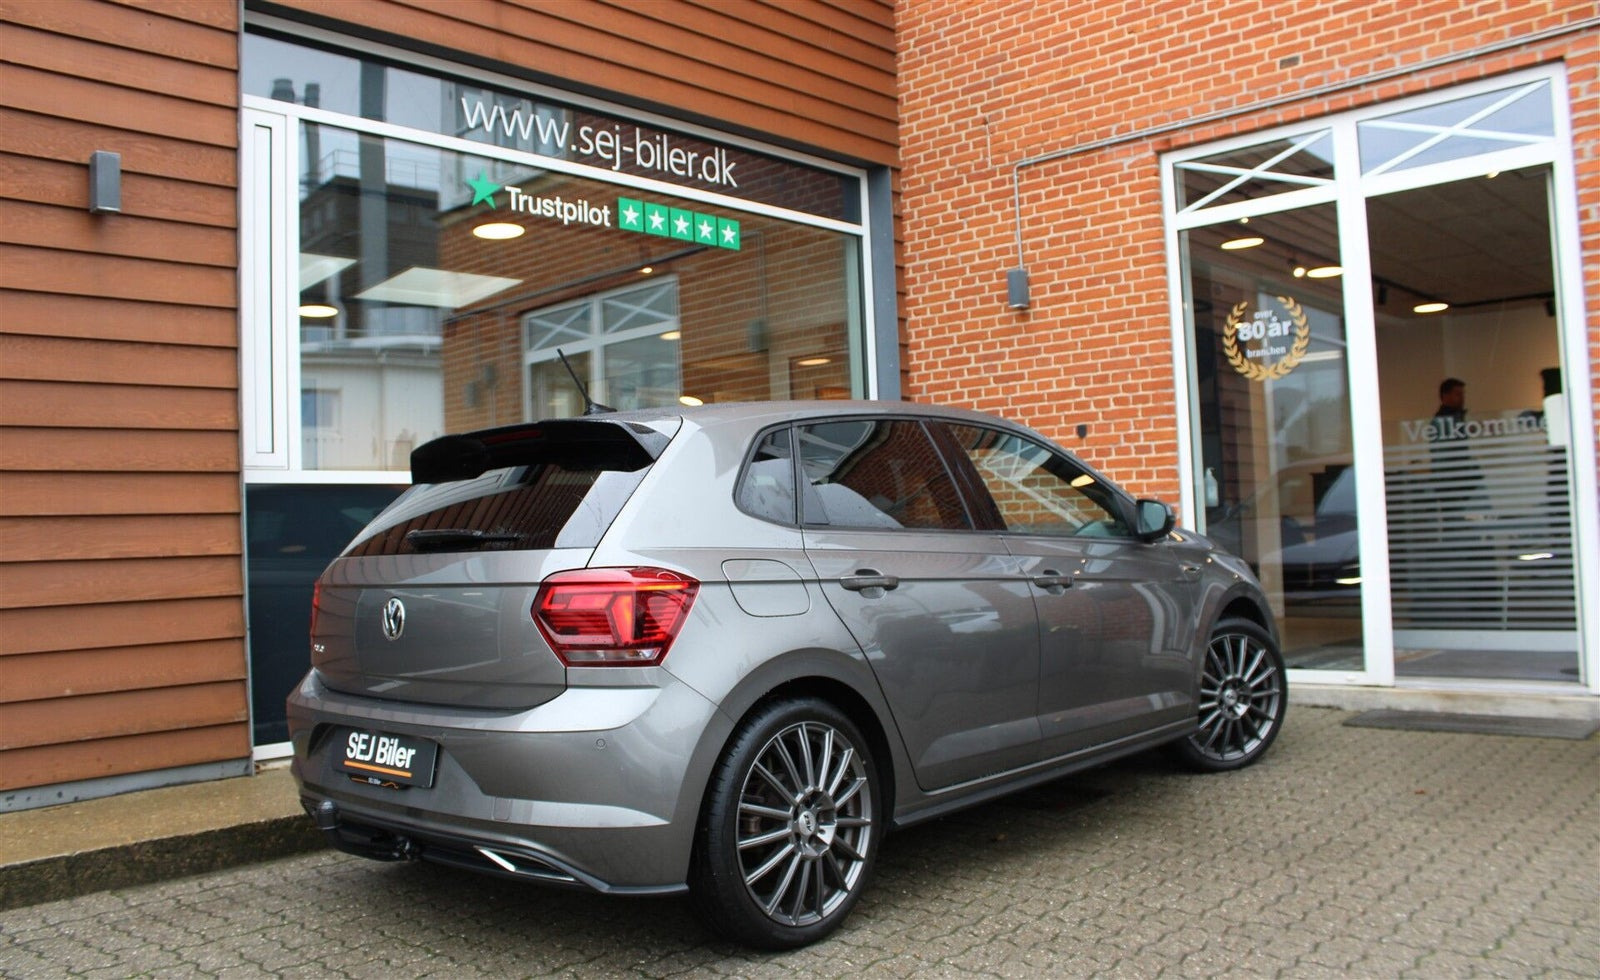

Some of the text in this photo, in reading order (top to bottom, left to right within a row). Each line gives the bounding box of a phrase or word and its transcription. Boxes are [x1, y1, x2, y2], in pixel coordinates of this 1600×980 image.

[461, 97, 738, 188] www.sej-biler.dk
[505, 185, 611, 227] Trustpilot
[1268, 315, 1292, 337] år
[346, 732, 416, 768] SEJ Biler
